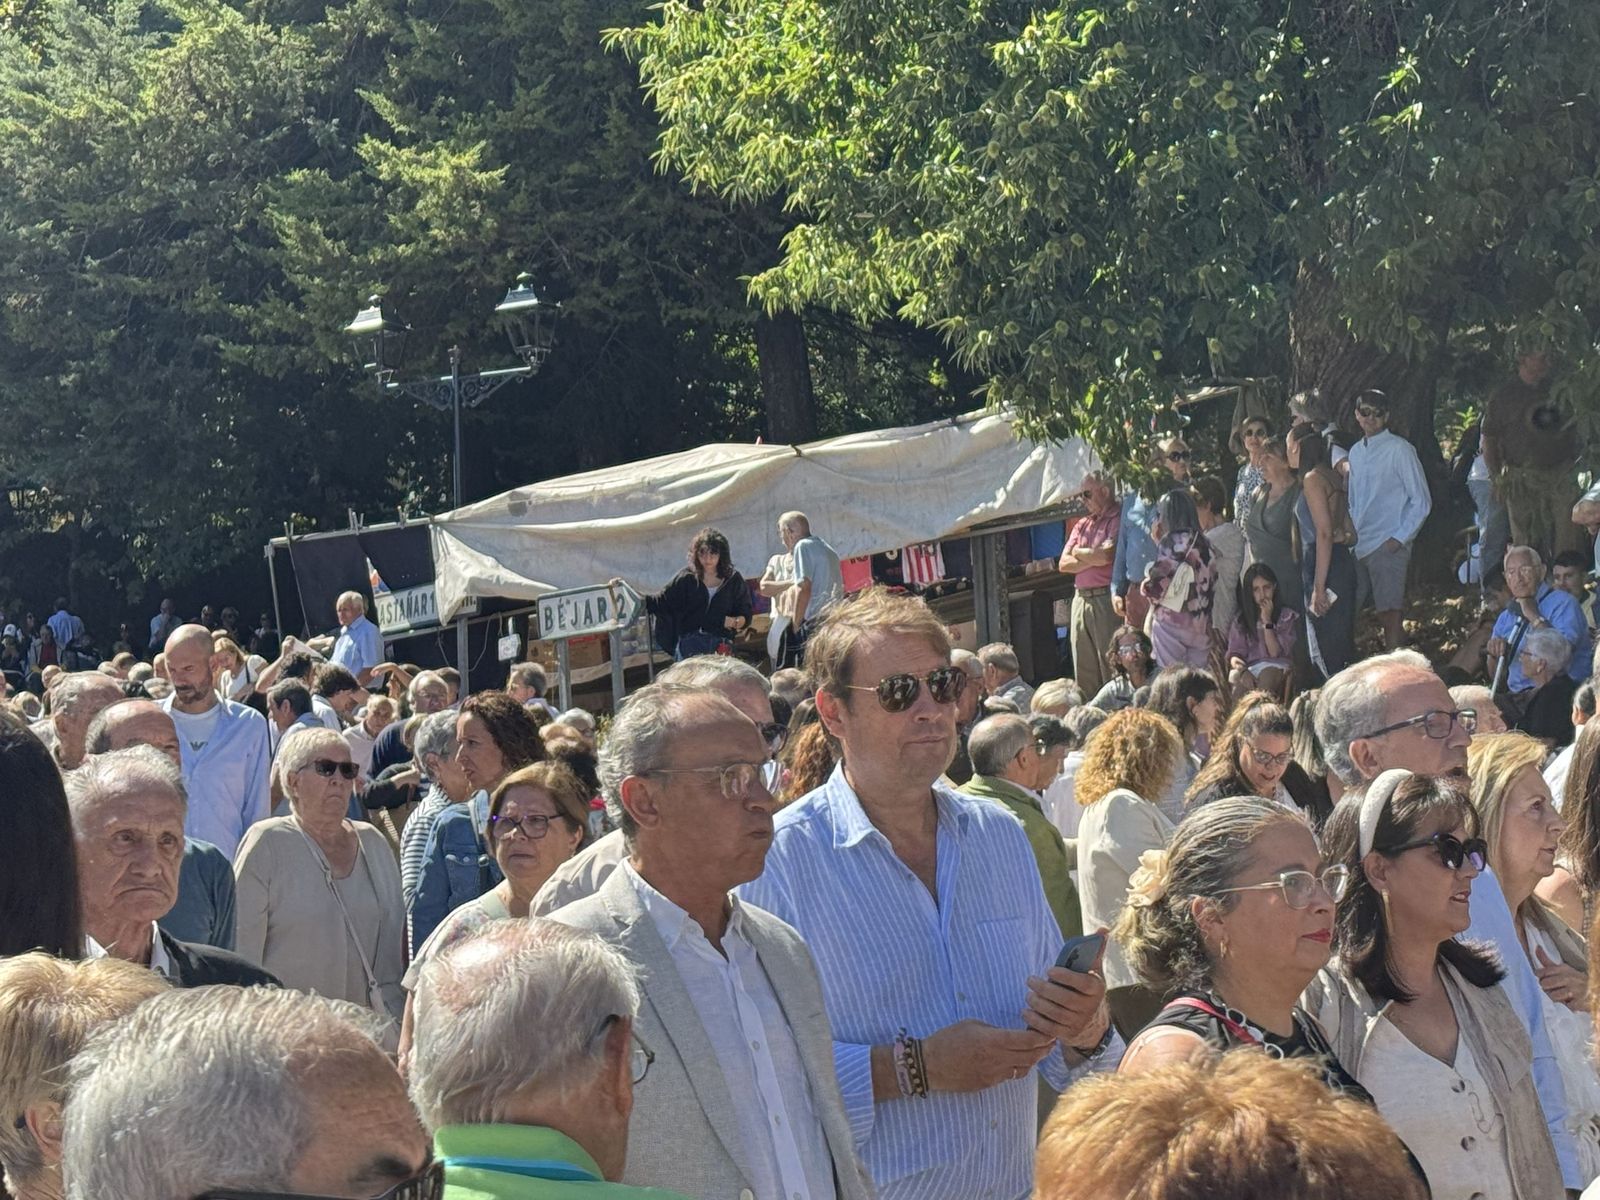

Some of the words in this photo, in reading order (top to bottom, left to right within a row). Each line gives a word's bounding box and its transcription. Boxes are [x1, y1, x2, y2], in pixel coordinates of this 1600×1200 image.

[379, 590, 428, 625] ASTAÑAR
[544, 596, 608, 631] BÉJAR
[616, 593, 627, 619] 2
